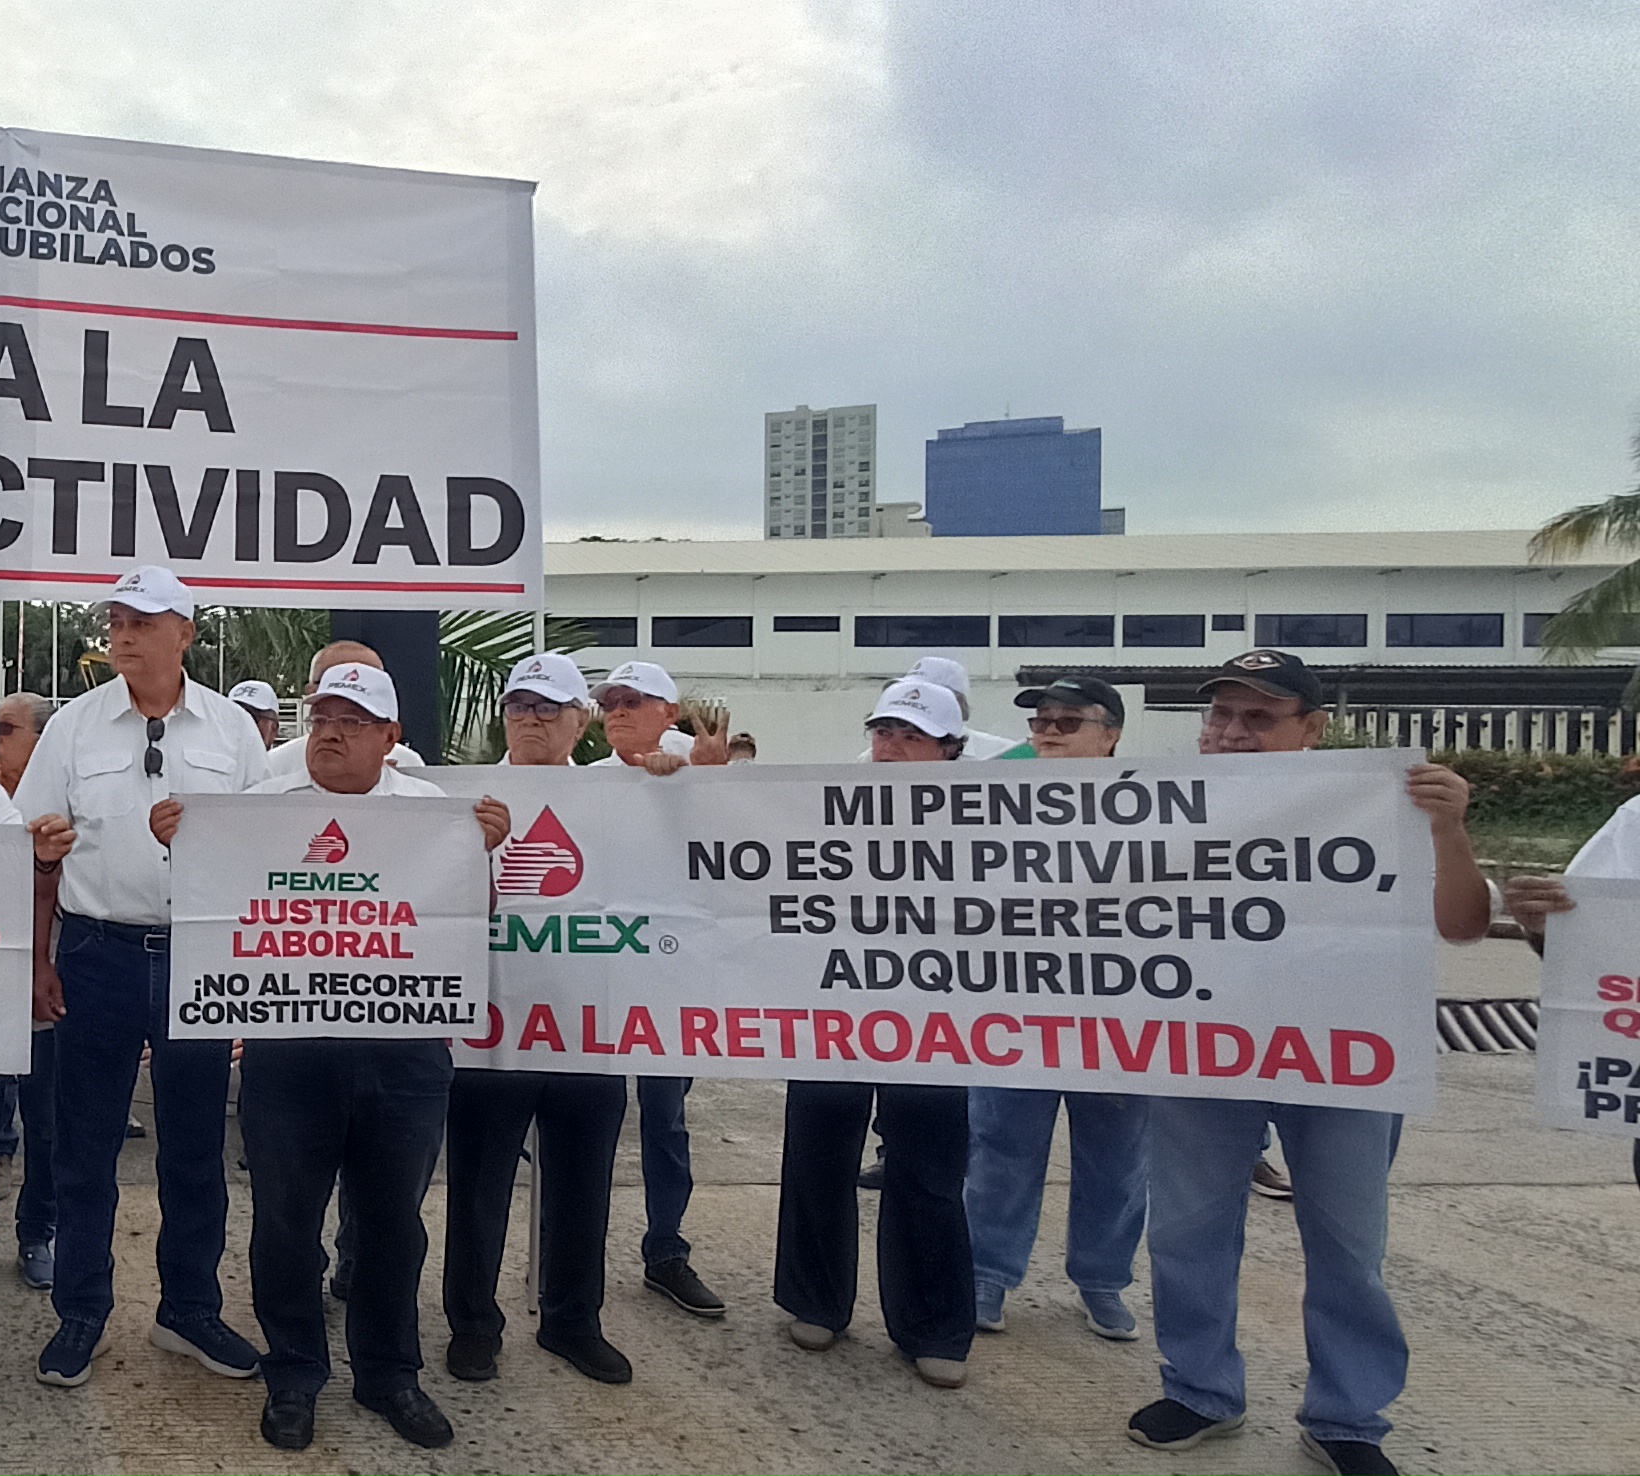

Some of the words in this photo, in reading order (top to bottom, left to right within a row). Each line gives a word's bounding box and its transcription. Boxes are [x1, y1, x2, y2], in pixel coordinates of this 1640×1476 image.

[81, 328, 236, 434] LA
[234, 686, 259, 697] CFE
[327, 682, 367, 693] PEMEX
[824, 785, 893, 826] MI
[911, 769, 1208, 826] PENSIÓN
[688, 840, 772, 881] NO
[786, 840, 853, 881] ES
[868, 840, 954, 882] UN
[971, 836, 1397, 892] PRIVILEGIO,
[268, 872, 380, 892] PEMEX
[238, 899, 418, 926] JUSTICIA
[769, 894, 836, 934] ES
[850, 895, 936, 935] UN
[953, 895, 1286, 941] DERECHO
[232, 930, 414, 959] LABORAL
[194, 973, 250, 1001] ¡NO
[258, 973, 300, 996] AL
[308, 973, 463, 998] RECORTE
[820, 949, 1213, 1000] ADQUIRIDO.
[179, 1000, 477, 1025] CONSTITUCIONAL!
[517, 1003, 567, 1052] A
[582, 1005, 667, 1056] LA
[679, 1006, 1395, 1087] RETROACTIVIDAD
